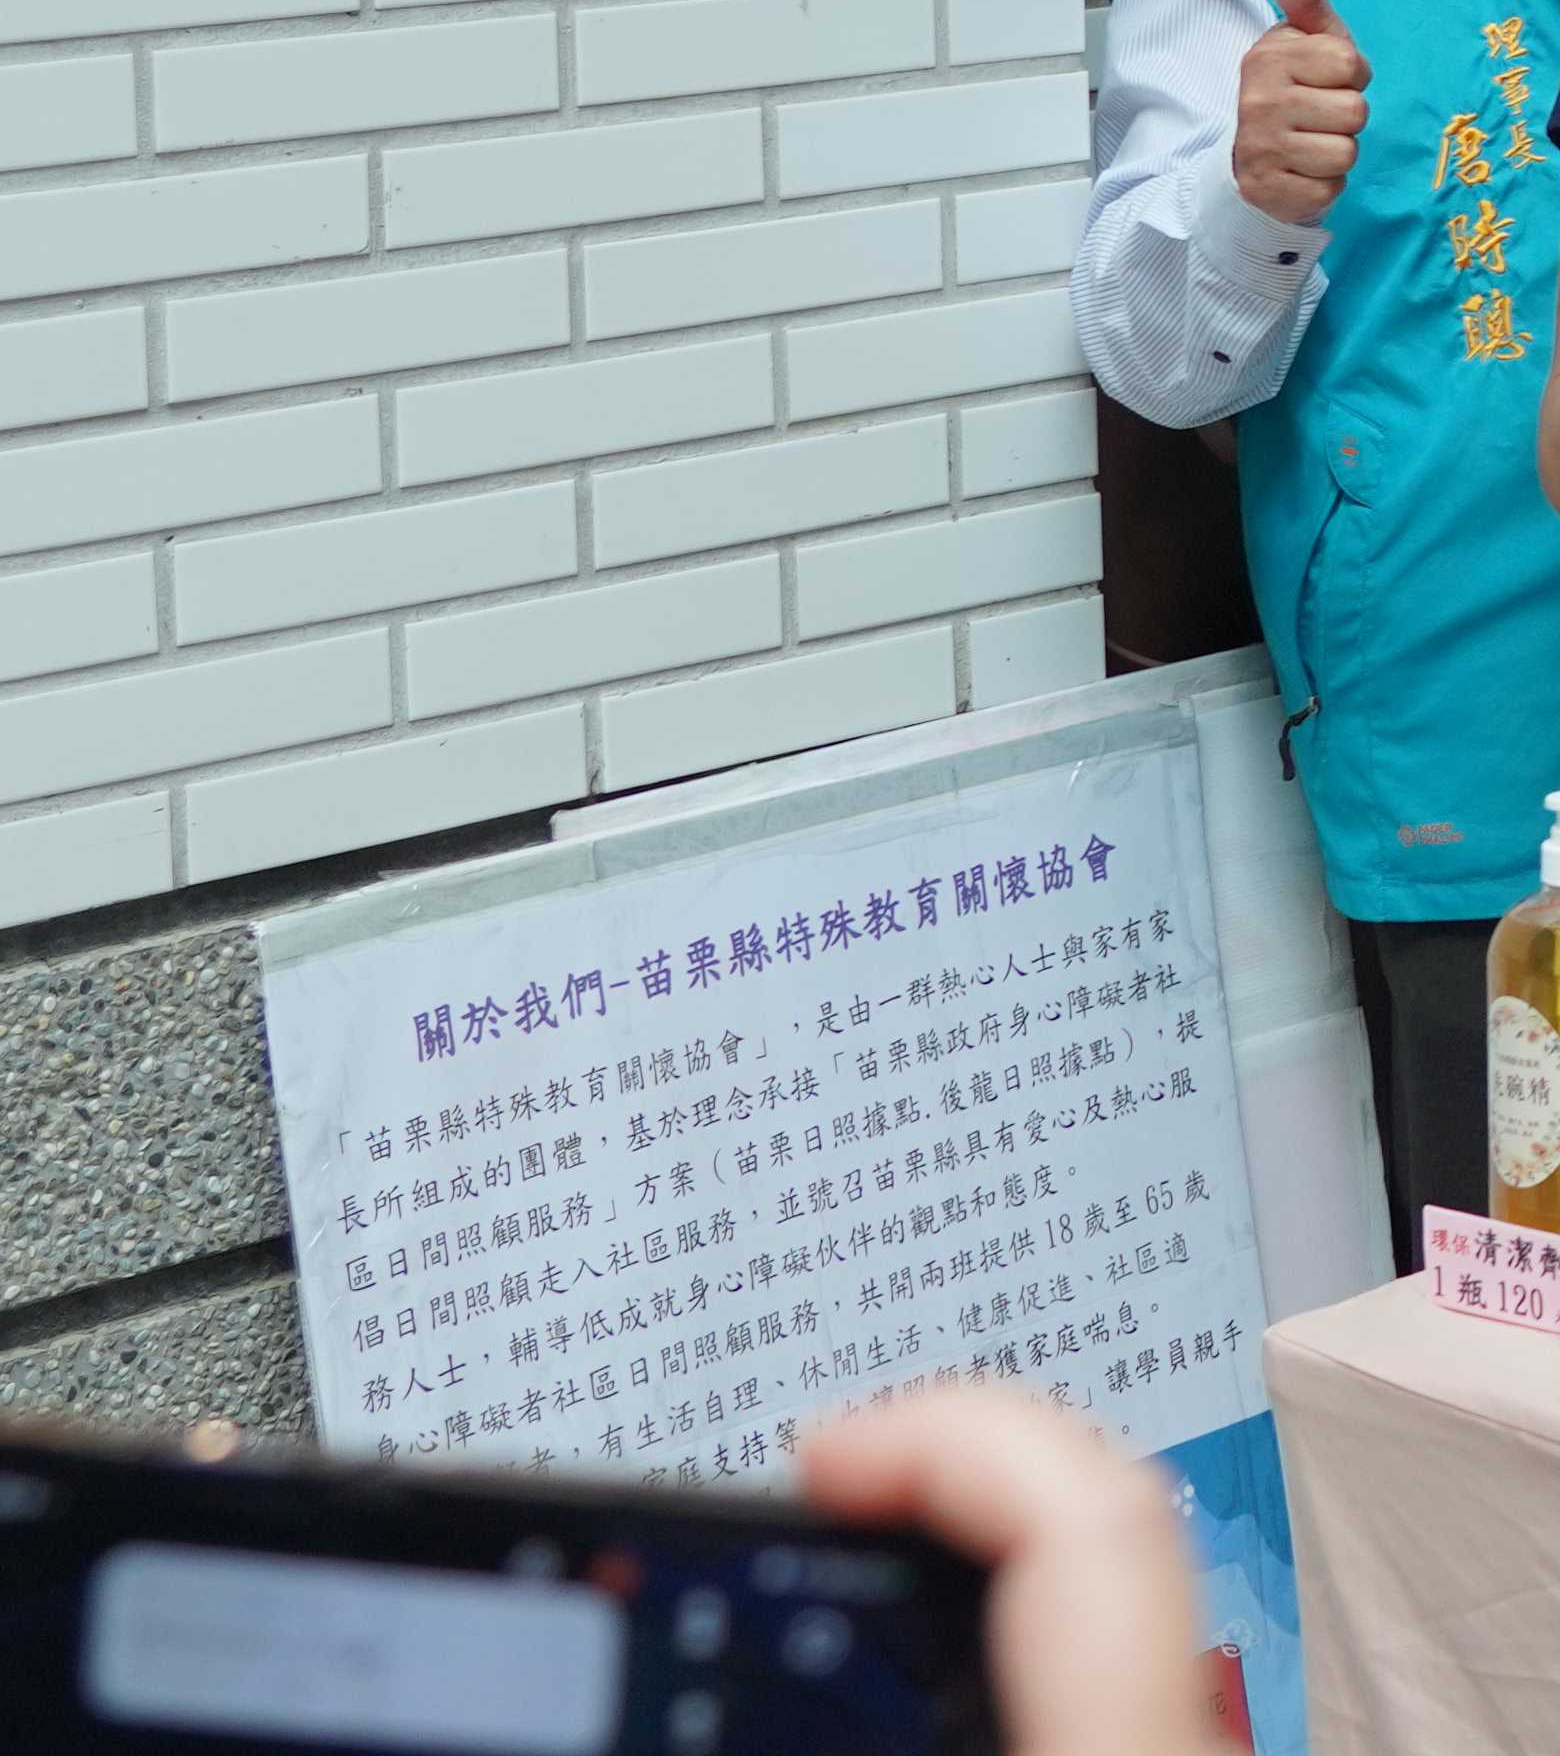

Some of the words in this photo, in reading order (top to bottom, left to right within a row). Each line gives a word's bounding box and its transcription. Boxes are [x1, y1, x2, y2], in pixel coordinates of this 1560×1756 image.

[1479, 14, 1548, 172] 理事長
[412, 832, 1118, 1063] 關於我們-苗栗縣特殊教育關懷協會
